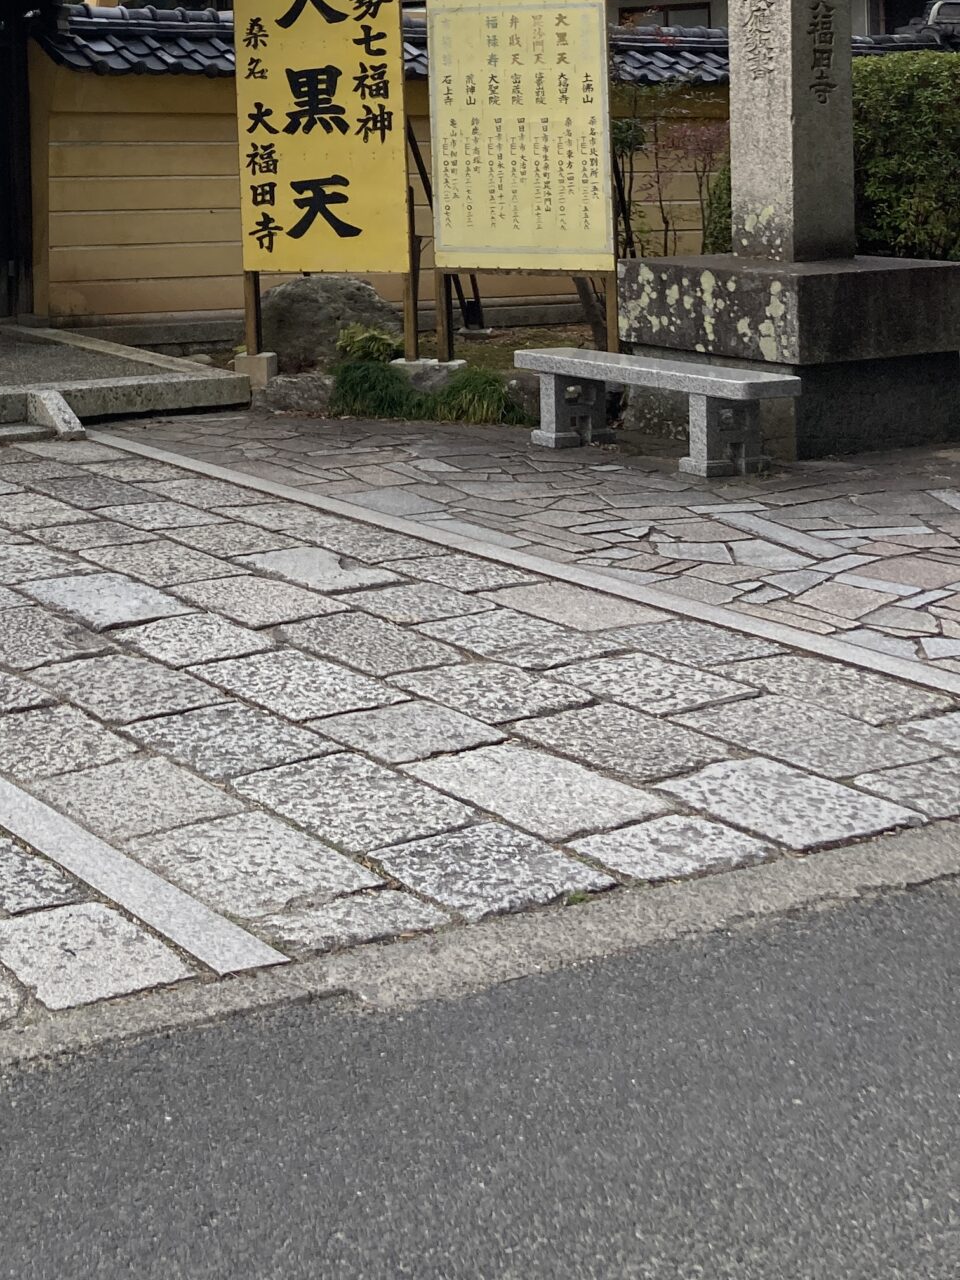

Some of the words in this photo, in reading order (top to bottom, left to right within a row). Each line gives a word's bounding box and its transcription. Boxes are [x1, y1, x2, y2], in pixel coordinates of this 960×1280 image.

[242, 17, 270, 80] 桑名
[554, 13, 571, 65] 大黒天
[441, 74, 454, 106] 石上寺
[488, 73, 502, 106] 大聖院
[557, 72, 571, 105] 大福田寺
[245, 102, 284, 254] 大福田寺
